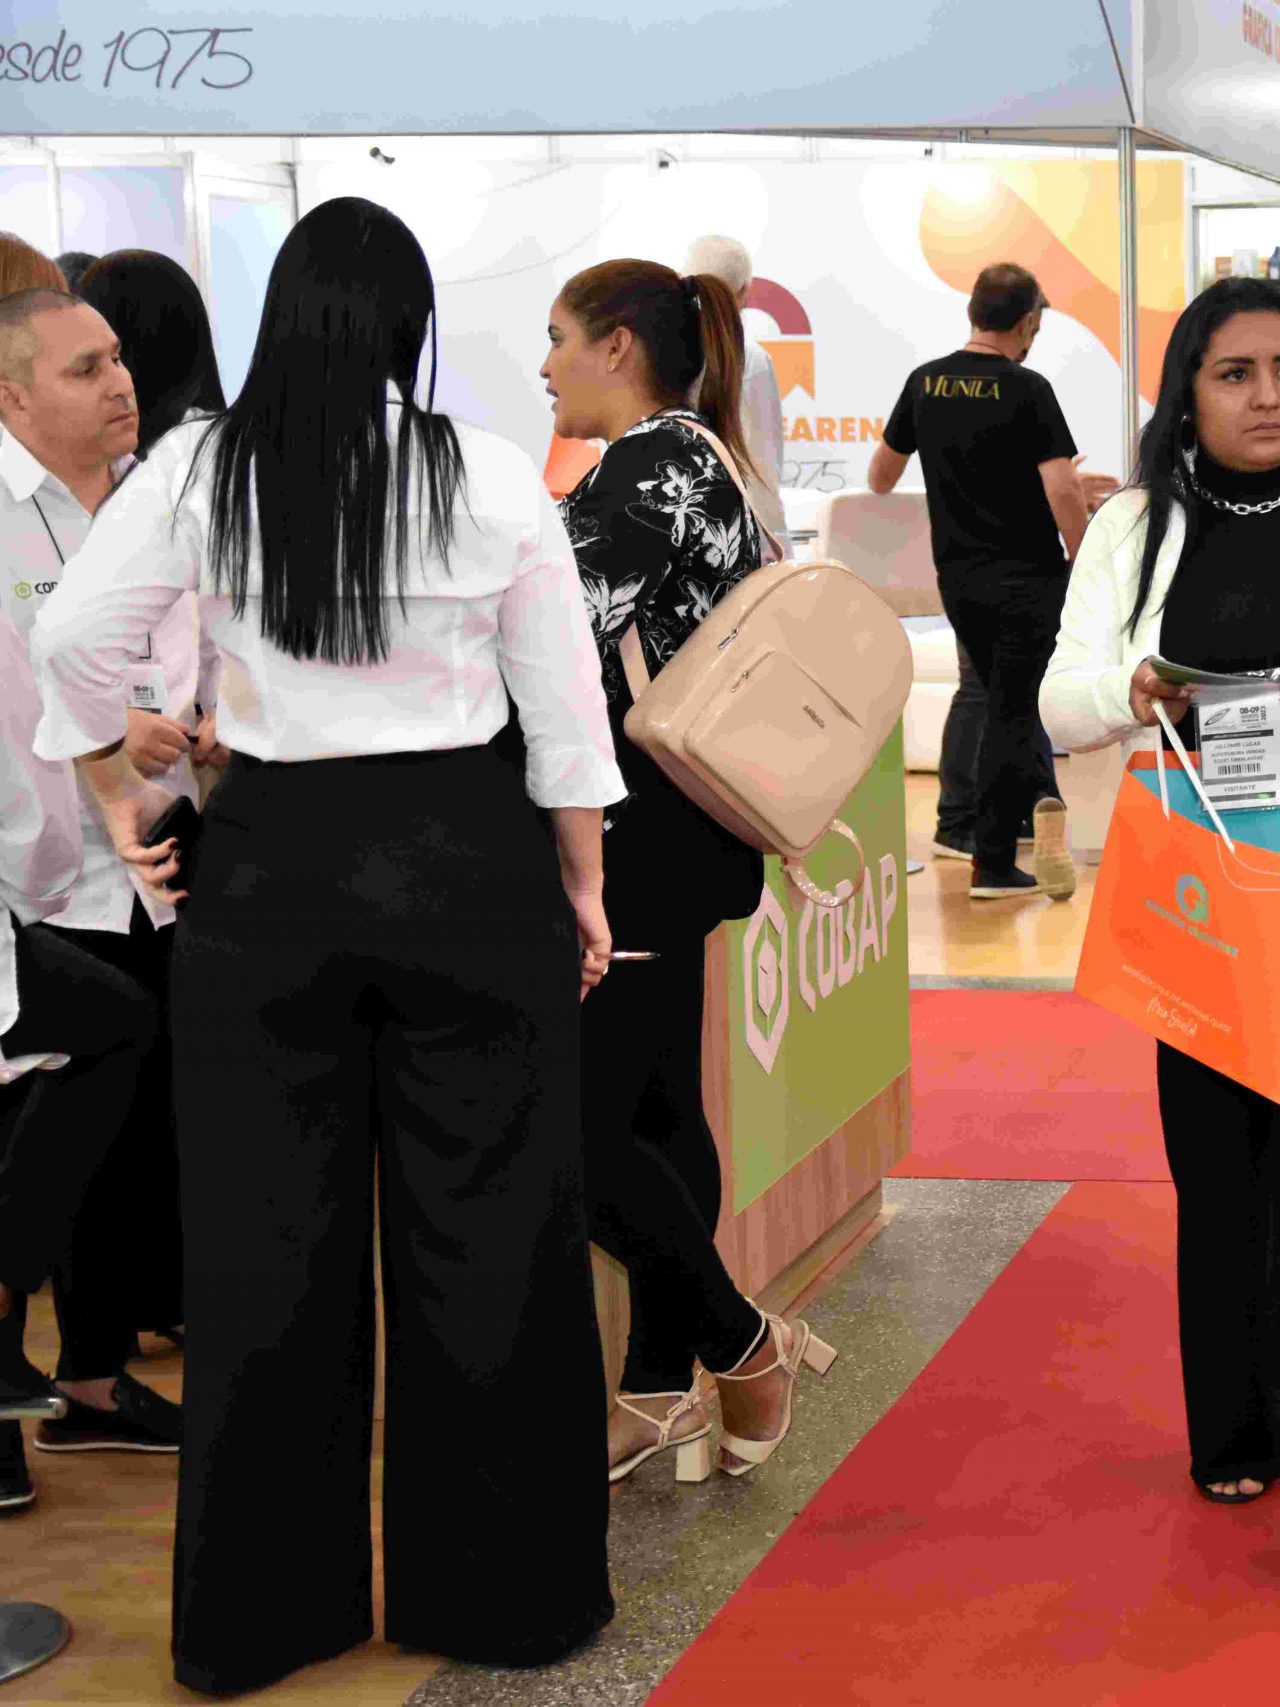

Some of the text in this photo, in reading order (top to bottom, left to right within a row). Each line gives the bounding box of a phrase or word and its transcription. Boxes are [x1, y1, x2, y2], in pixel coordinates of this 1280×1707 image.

[0, 27, 253, 89] sde 1975
[1240, 706, 1260, 714] 08-09
[798, 852, 898, 1014] COBAP
